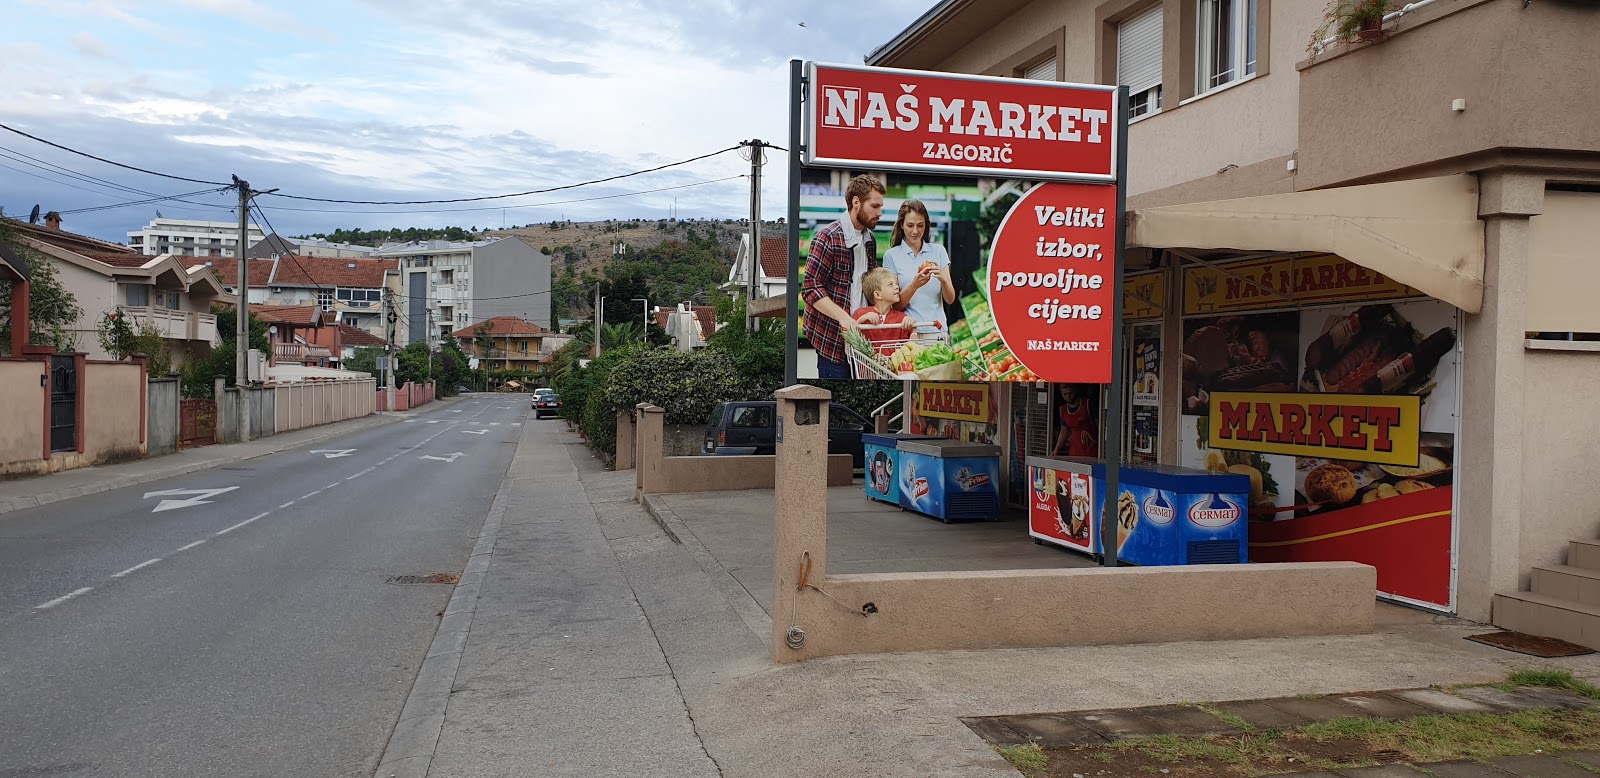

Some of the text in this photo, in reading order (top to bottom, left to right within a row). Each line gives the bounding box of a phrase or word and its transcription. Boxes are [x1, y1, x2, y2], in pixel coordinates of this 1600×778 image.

[822, 83, 1107, 143] NAŠ MARKET
[922, 142, 1012, 163] ZAGORIČ
[1034, 205, 1104, 228] Veliki
[1036, 237, 1103, 261] izbor,
[1028, 299, 1102, 324] cijene
[1027, 338, 1099, 351] NAŠ MARKET
[923, 388, 983, 416] MARKET
[1219, 401, 1401, 453] MARKET
[1036, 502, 1050, 511] ALGIDA
